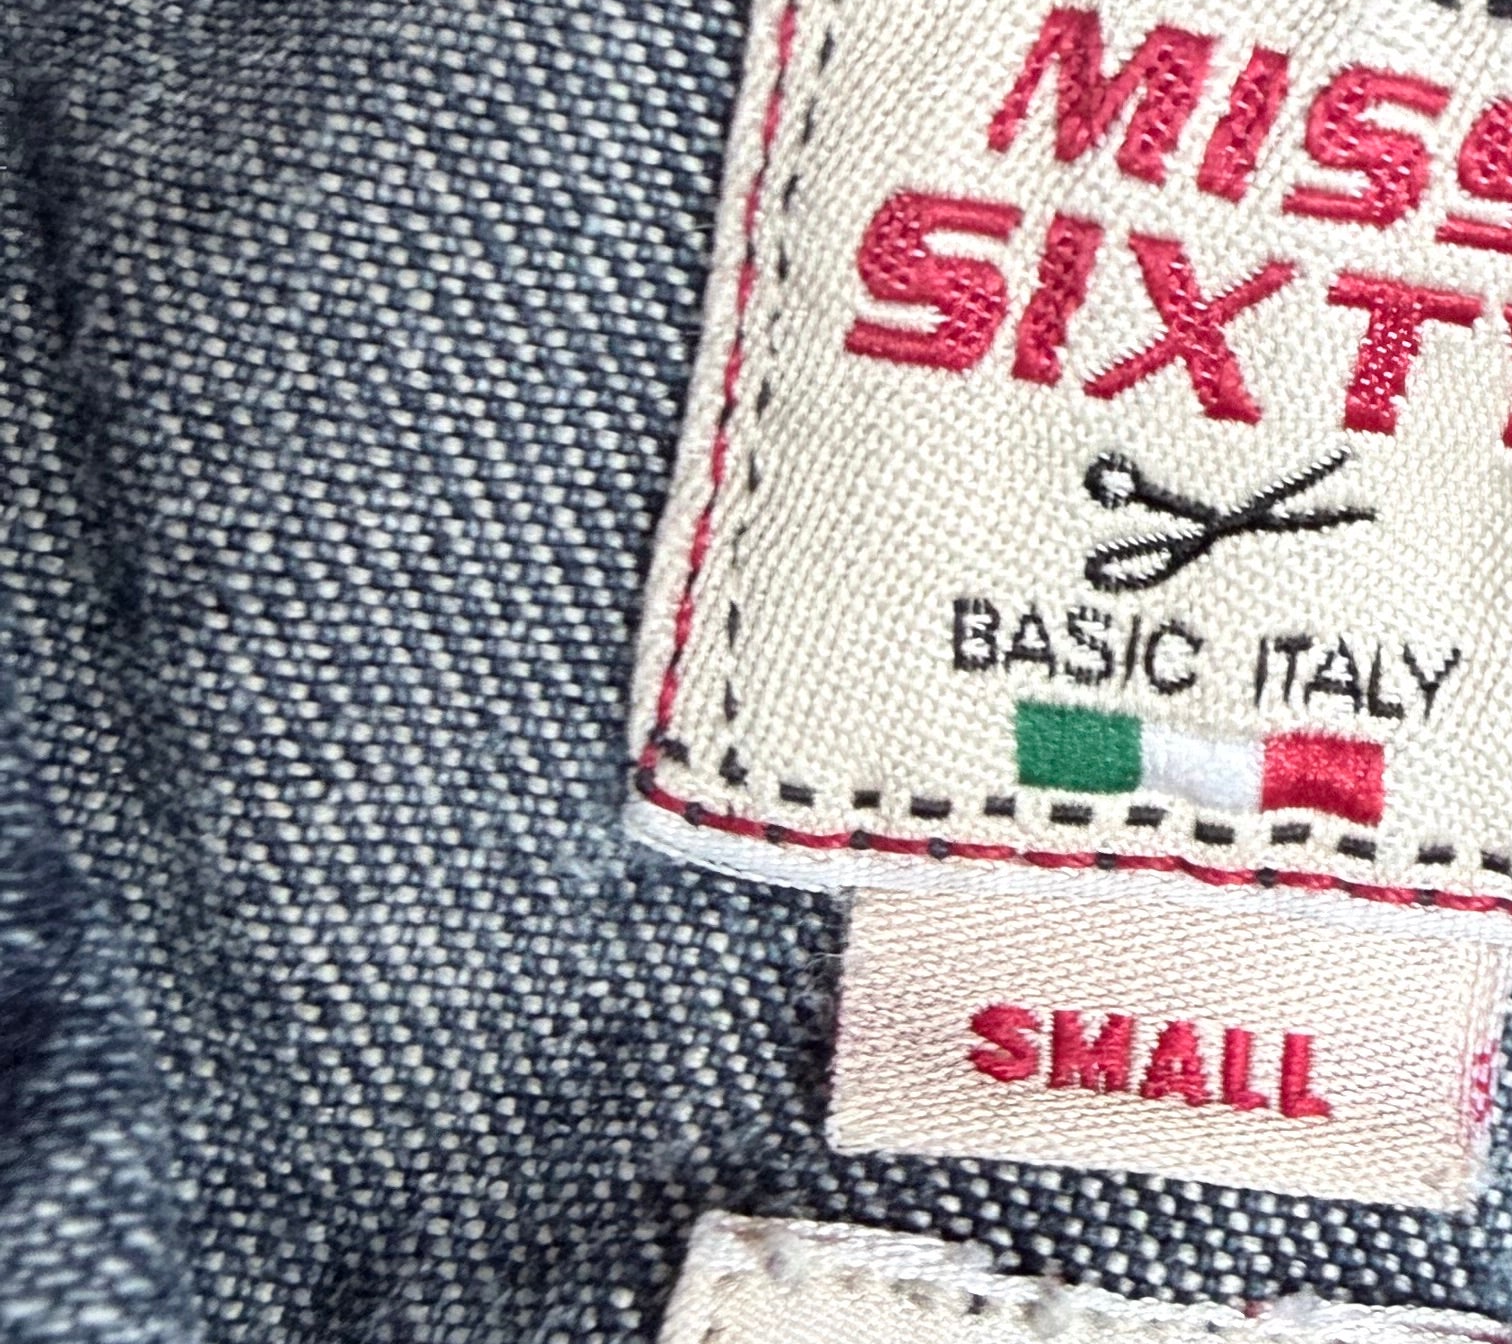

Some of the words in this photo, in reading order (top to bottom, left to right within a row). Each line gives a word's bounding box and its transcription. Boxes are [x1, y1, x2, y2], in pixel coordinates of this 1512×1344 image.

[951, 595, 1206, 696] BASIC
[1255, 633, 1463, 720] ITALY
[968, 1001, 1333, 1119] SMALL
